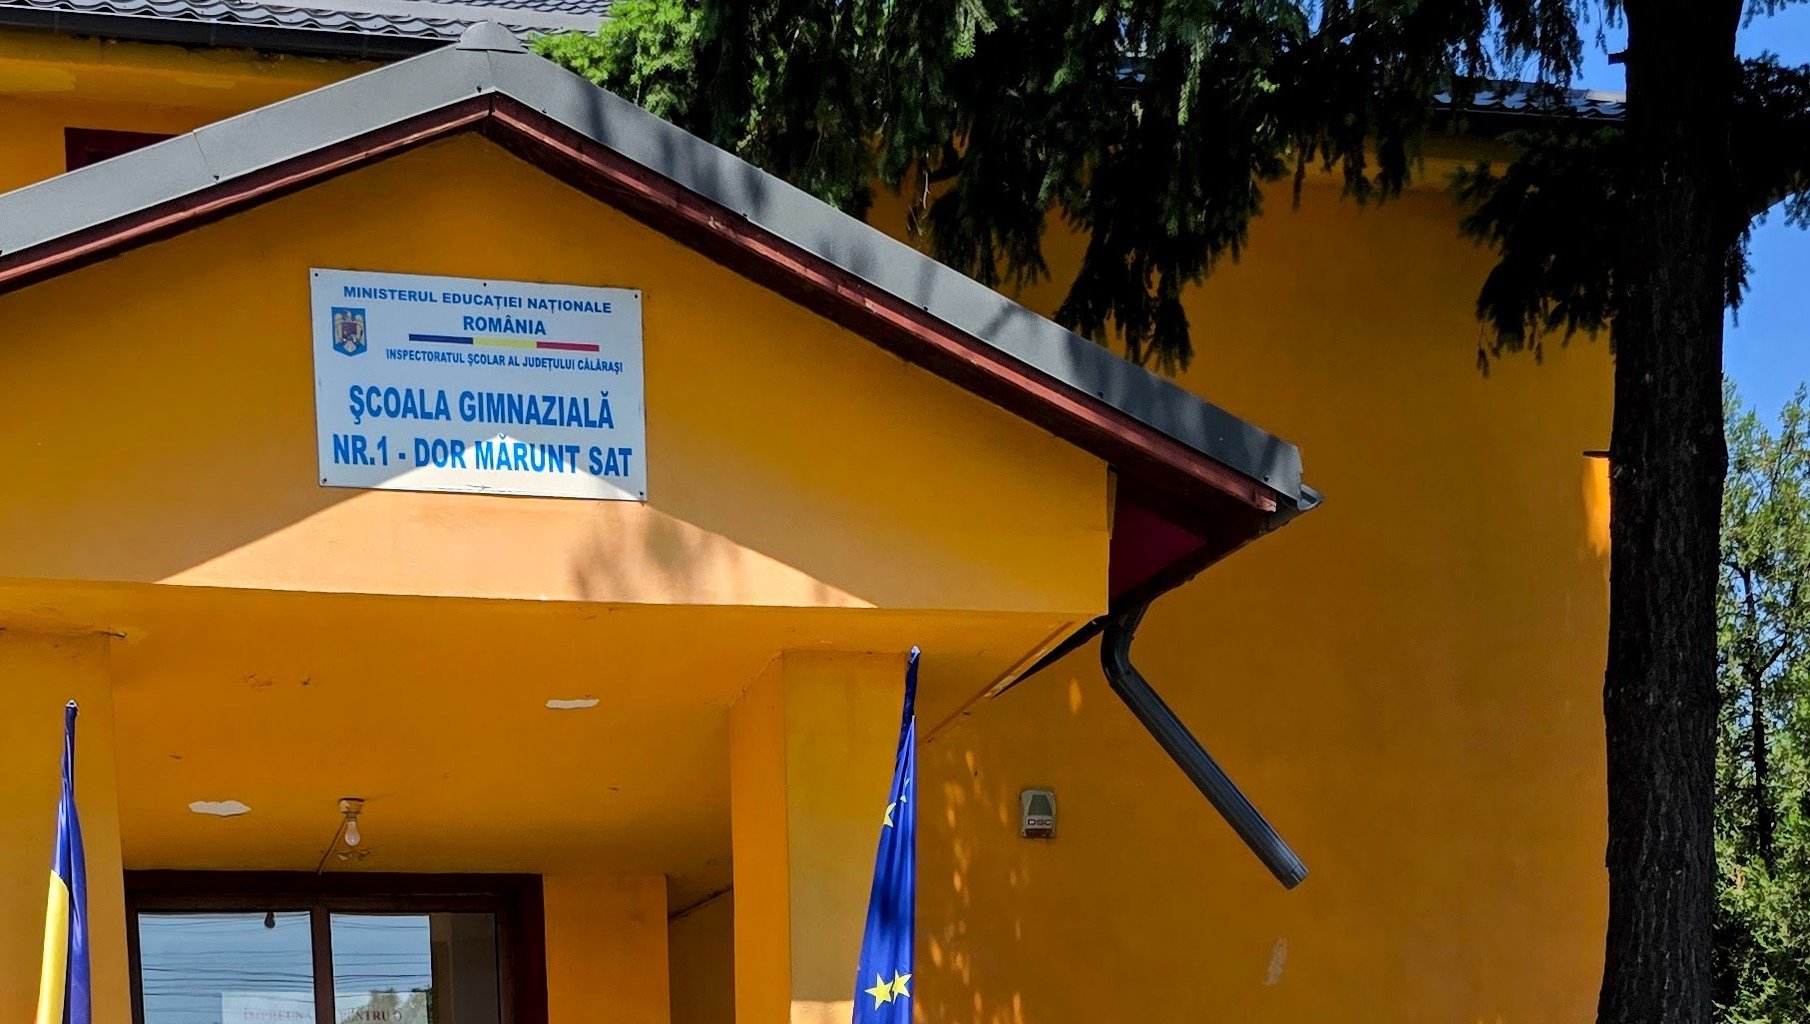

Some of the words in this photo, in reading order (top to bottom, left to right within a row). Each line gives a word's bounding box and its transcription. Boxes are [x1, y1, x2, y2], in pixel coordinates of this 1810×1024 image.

[343, 286, 438, 303] MINISTERUL
[463, 315, 547, 336] ROMÂNIA
[386, 349, 465, 364] INSPECTORATUL
[507, 355, 520, 367] AL
[459, 390, 615, 430] GIMNAZIALĂ
[333, 433, 388, 466] NR.1
[398, 452, 406, 460] -
[414, 438, 467, 469] DOR
[475, 433, 580, 474] MĂRUNT
[588, 446, 633, 477] SAT
